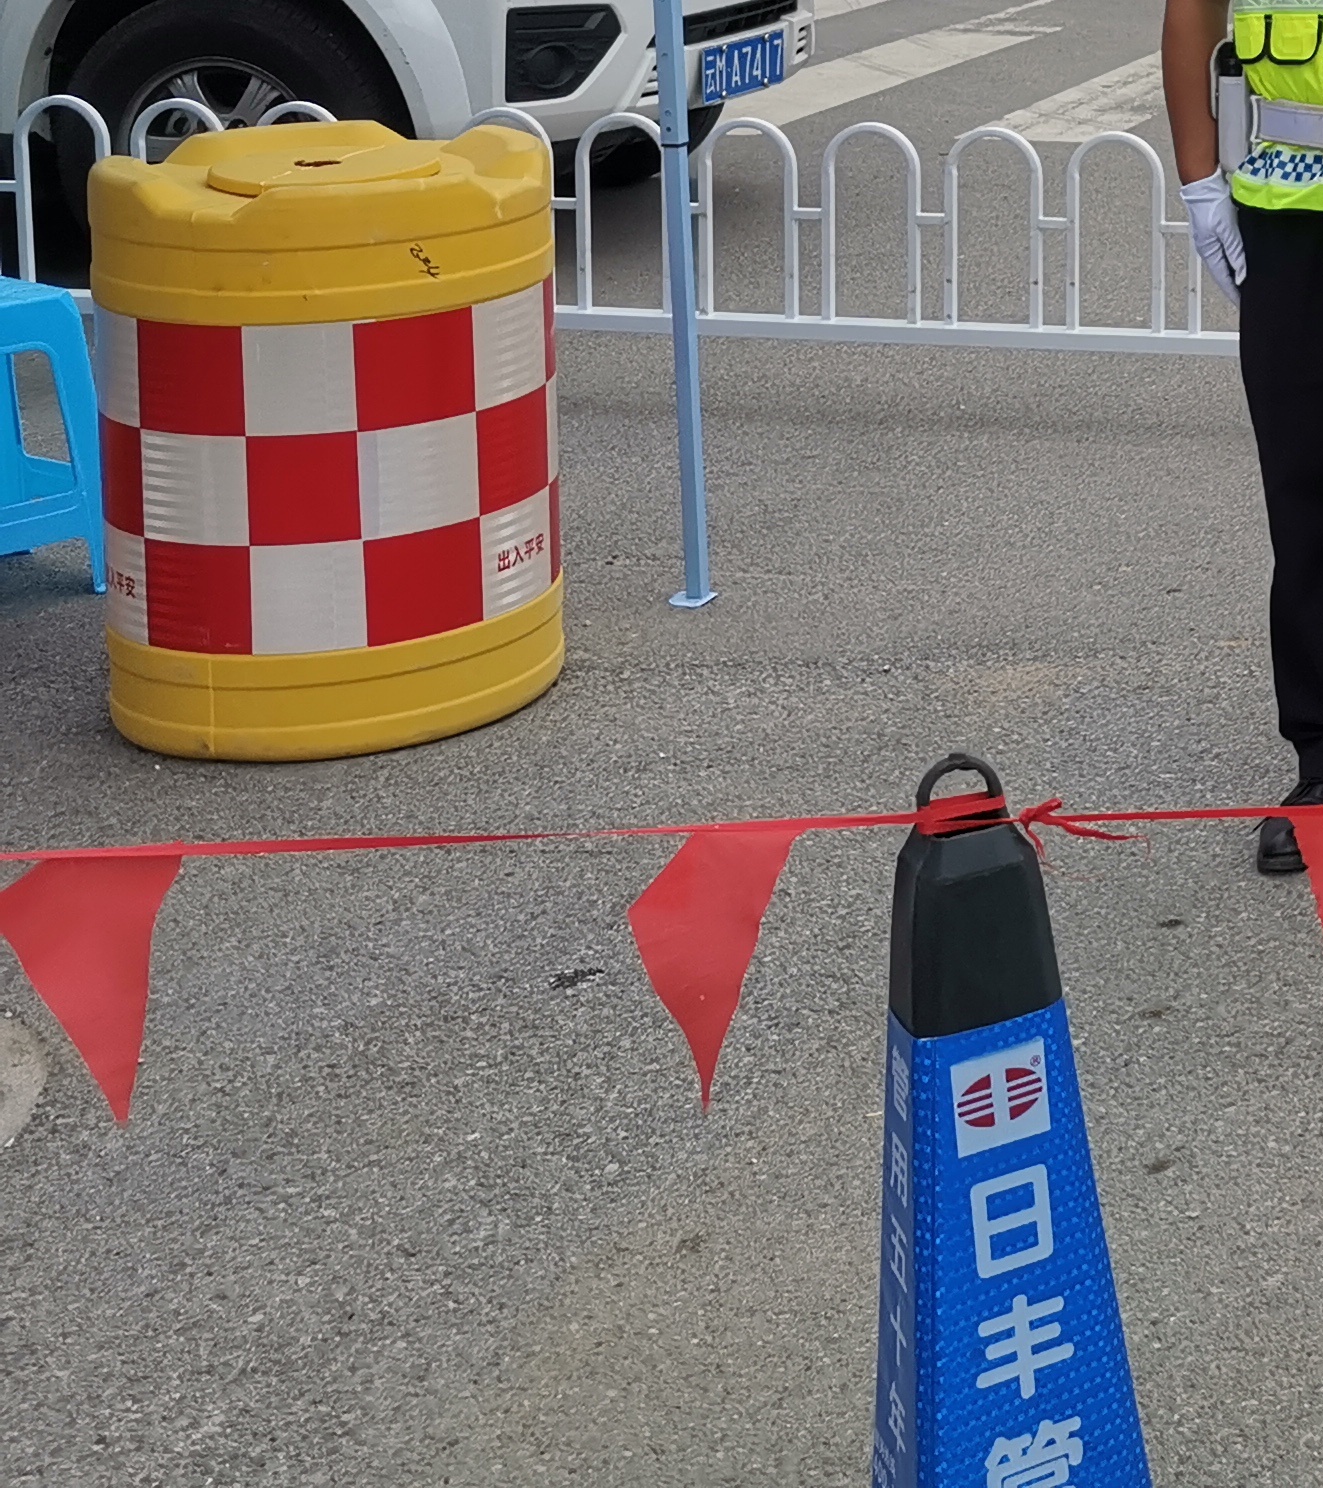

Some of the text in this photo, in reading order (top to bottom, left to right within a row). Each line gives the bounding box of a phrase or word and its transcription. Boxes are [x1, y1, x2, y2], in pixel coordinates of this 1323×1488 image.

[497, 532, 545, 573] 出入平安
[108, 564, 137, 599] 入平安
